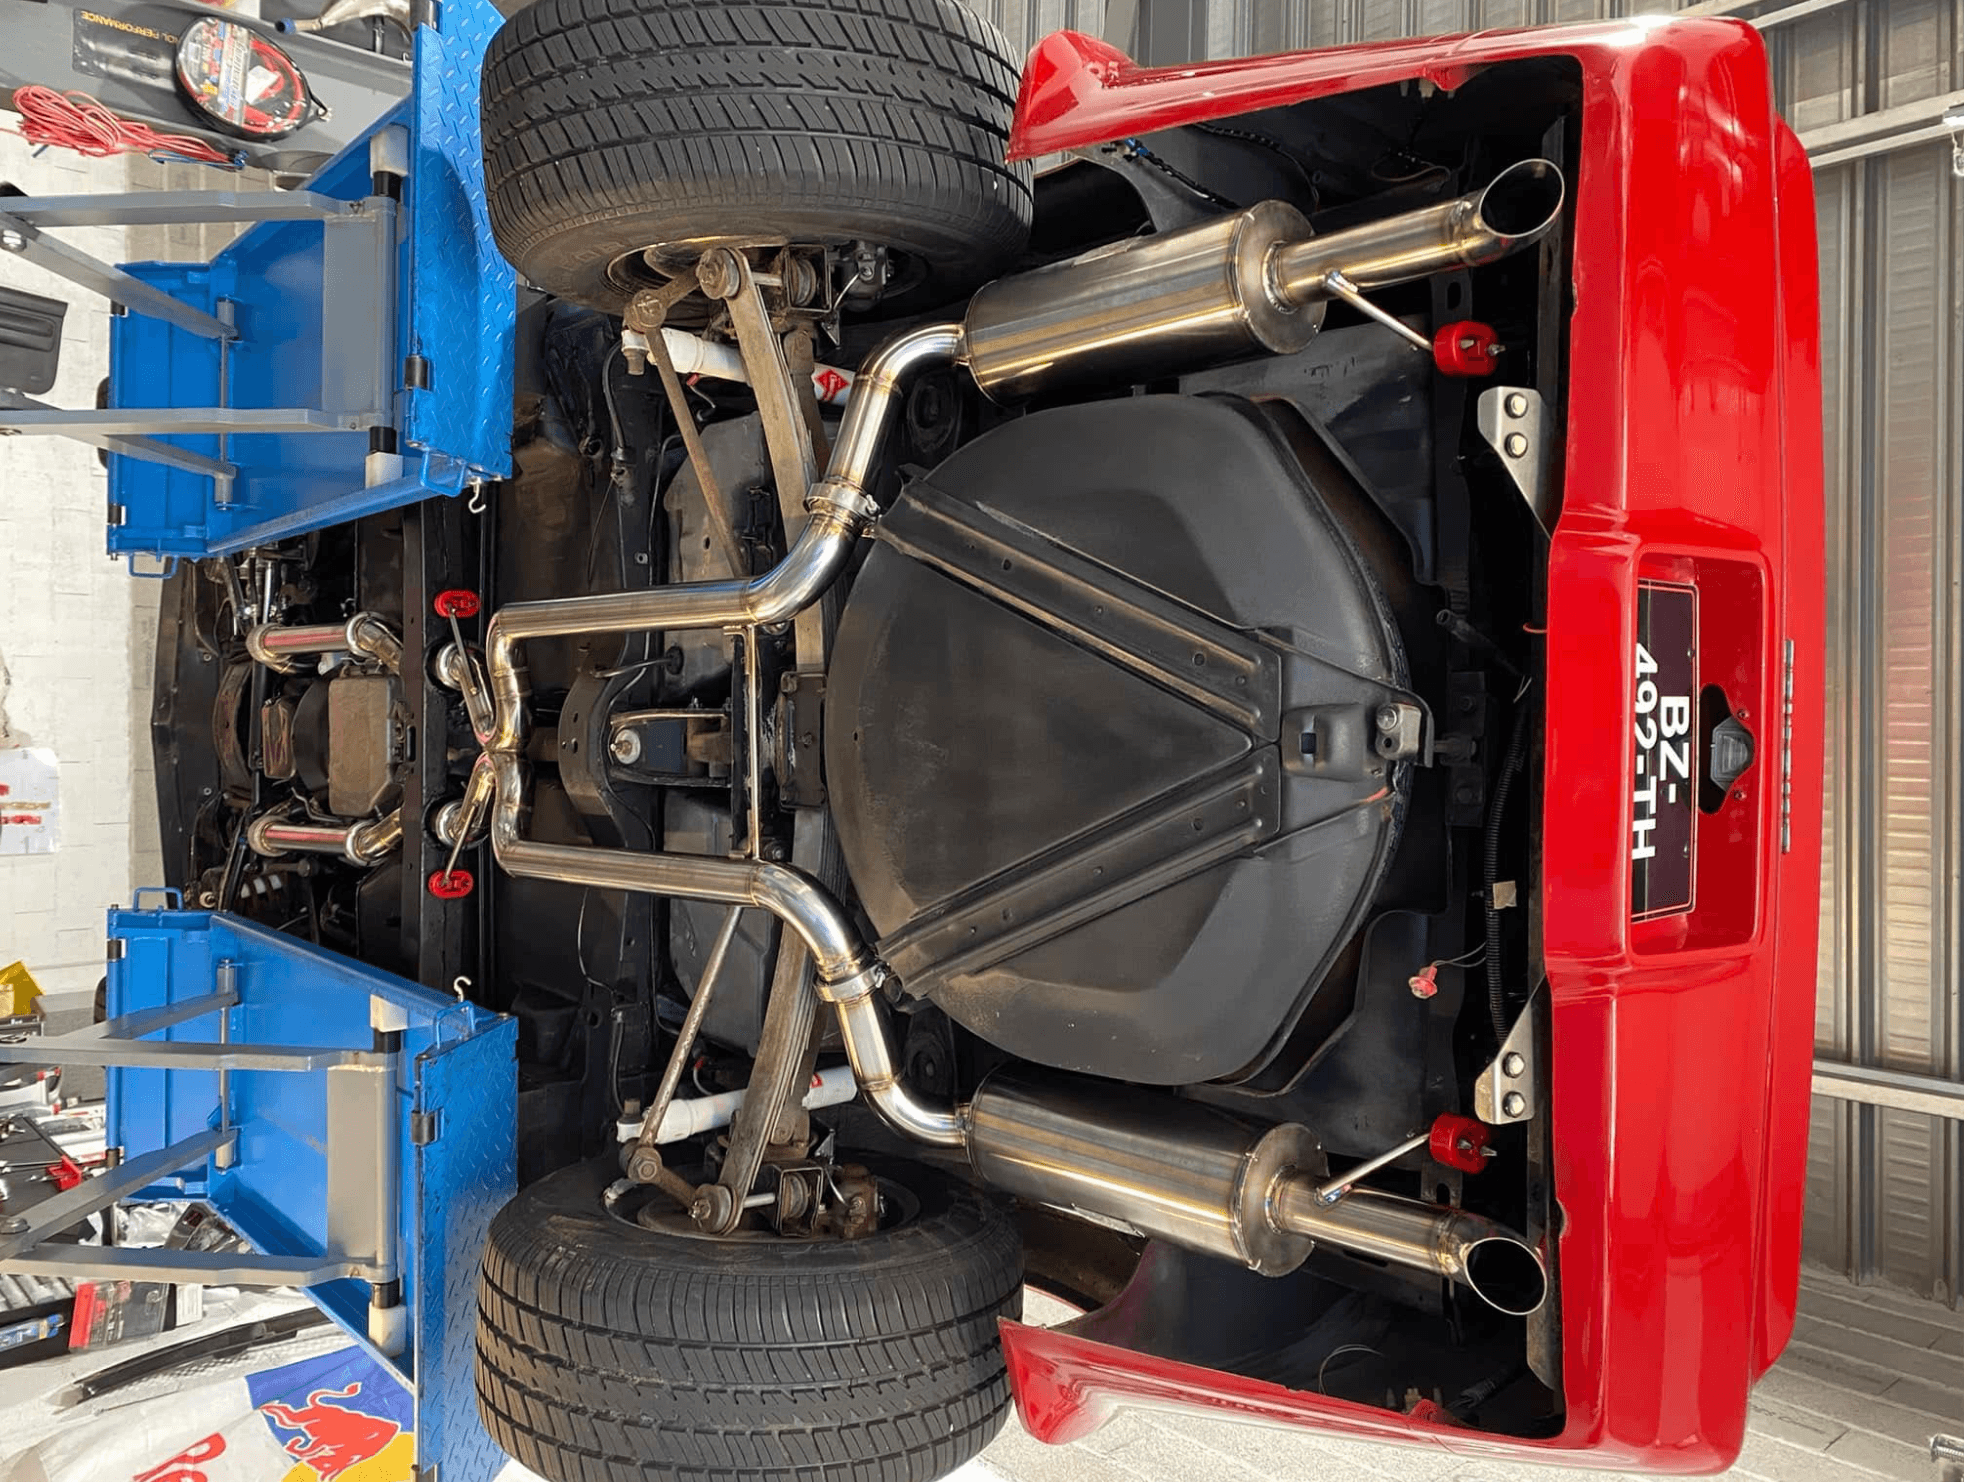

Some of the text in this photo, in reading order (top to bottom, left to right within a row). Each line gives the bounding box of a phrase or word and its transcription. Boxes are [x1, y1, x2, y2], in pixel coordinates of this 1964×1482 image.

[80, 10, 159, 39] PERFORMANCE
[1631, 642, 1658, 860] 492-TH
[1659, 695, 1690, 804] BZ-
